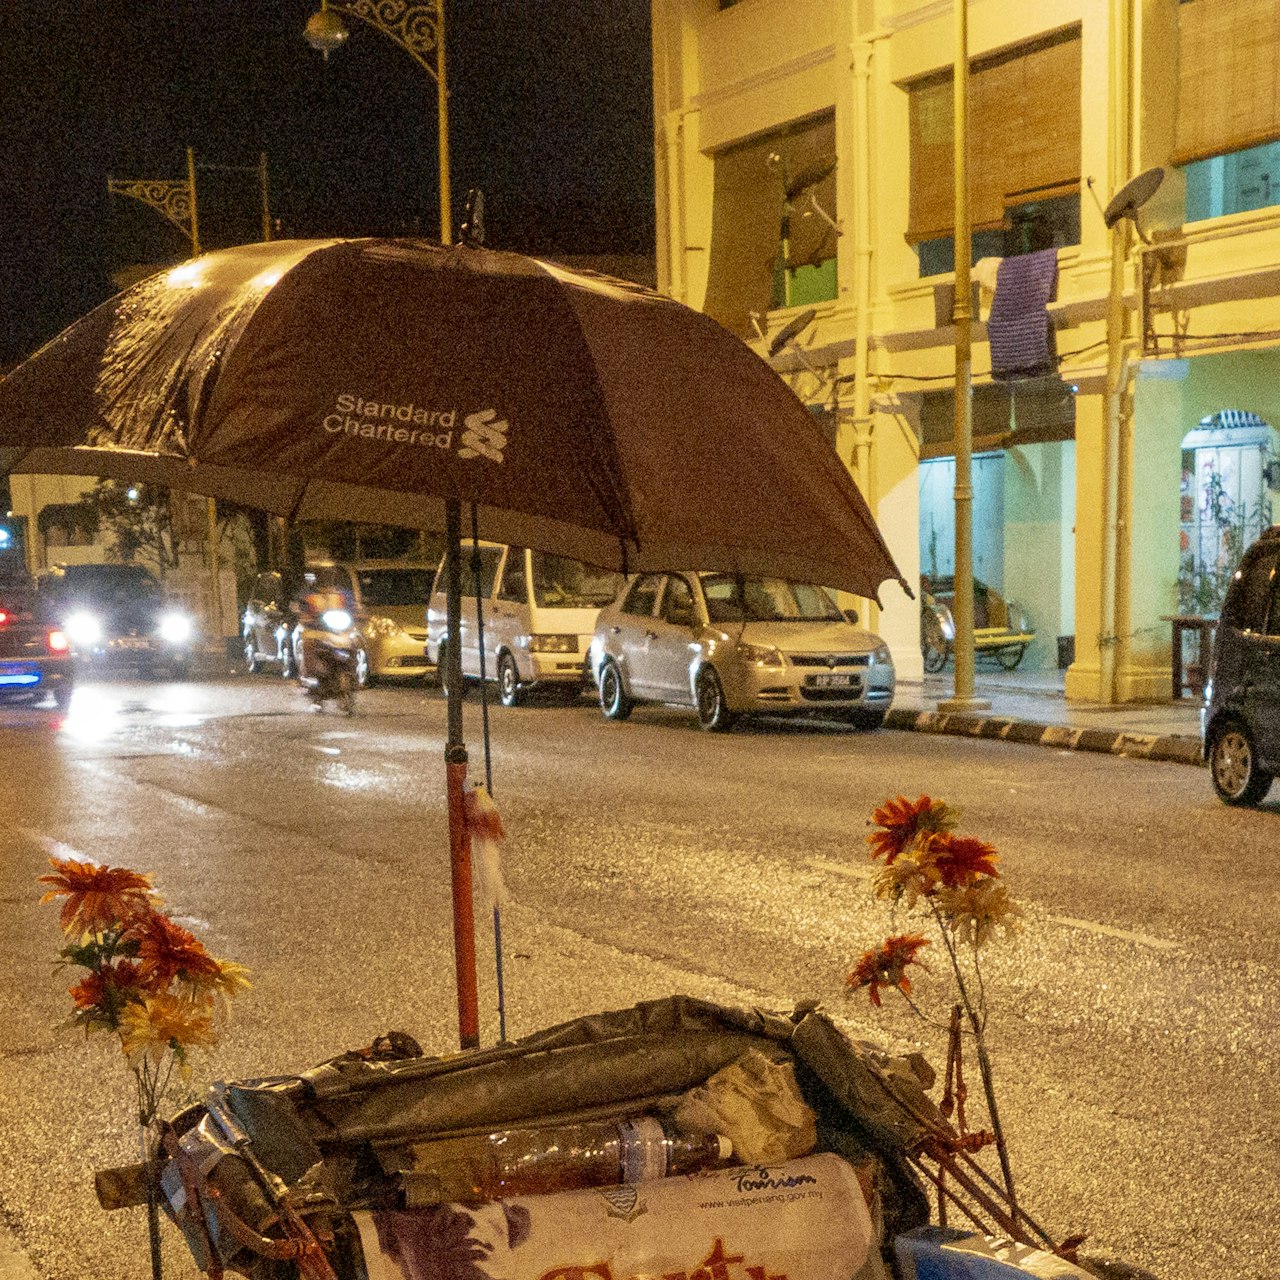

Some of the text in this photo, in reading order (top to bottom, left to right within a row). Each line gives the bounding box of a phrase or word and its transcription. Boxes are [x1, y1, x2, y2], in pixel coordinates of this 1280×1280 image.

[336, 394, 457, 428] Standard
[323, 414, 453, 449] Chartered
[699, 1191, 823, 1210] www.visitpenang.gov.my
